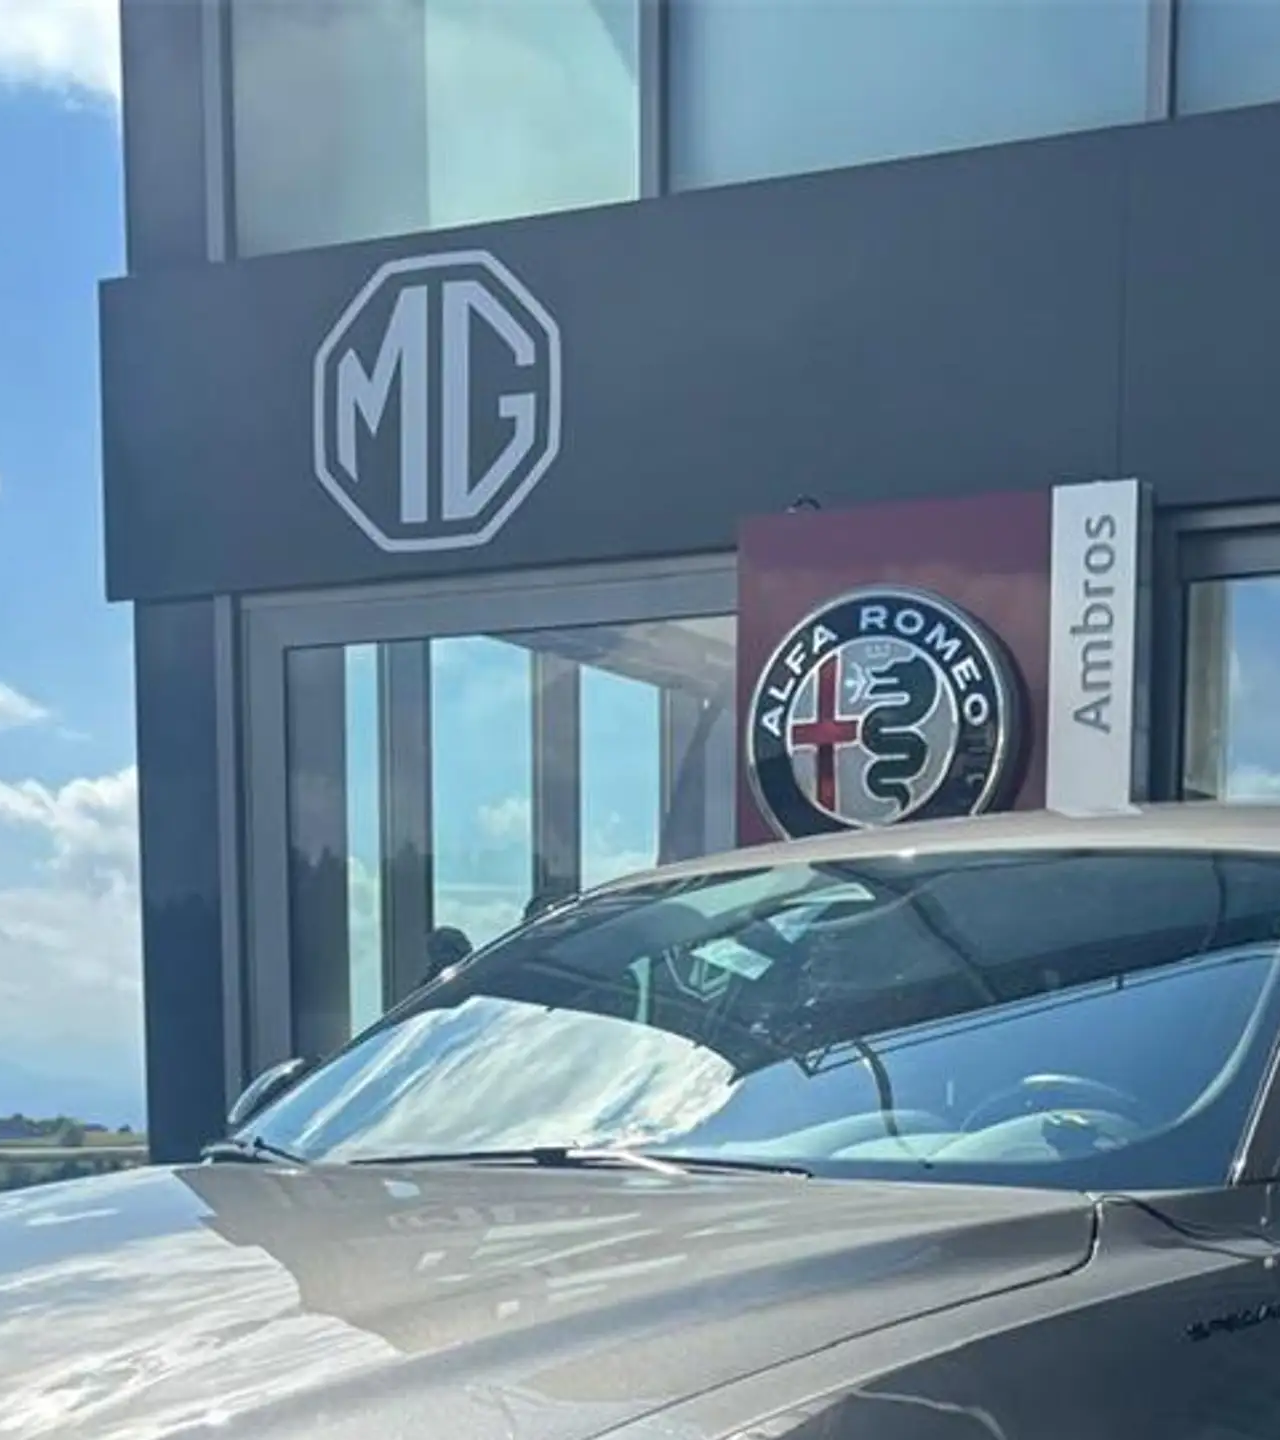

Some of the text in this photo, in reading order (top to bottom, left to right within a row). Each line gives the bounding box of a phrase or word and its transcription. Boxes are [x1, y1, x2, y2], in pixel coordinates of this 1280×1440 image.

[336, 279, 536, 523] MG
[760, 604, 990, 738] ALFA ROMEO
[1069, 513, 1116, 734] Ambros
